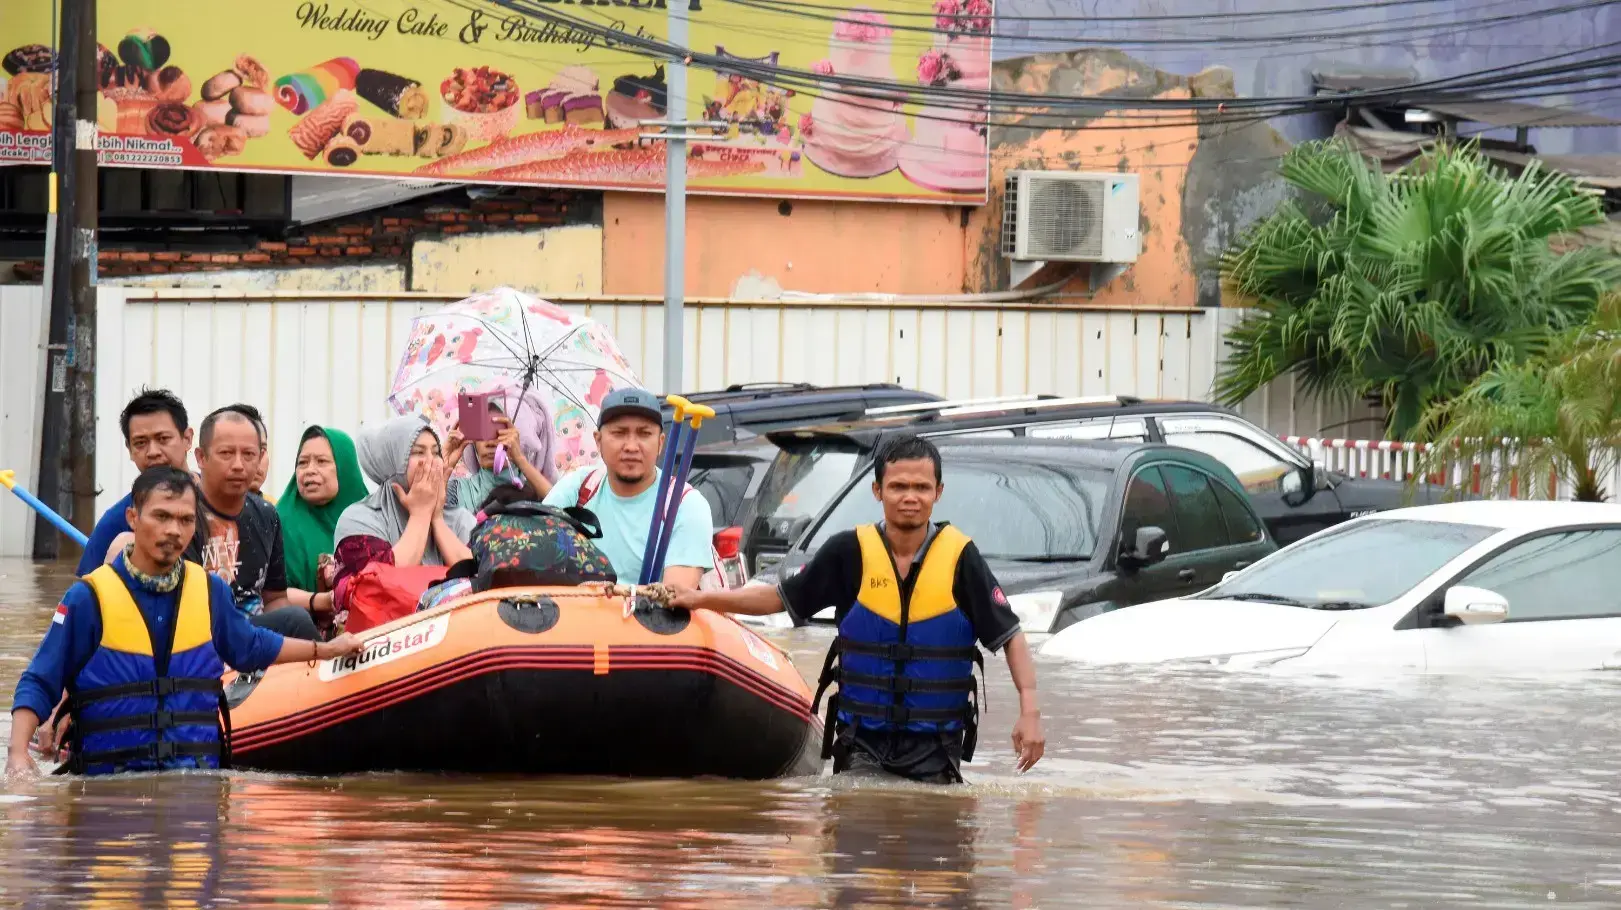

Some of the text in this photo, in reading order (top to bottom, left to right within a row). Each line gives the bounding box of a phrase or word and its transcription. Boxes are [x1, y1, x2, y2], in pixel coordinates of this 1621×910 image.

[296, 1, 390, 41] Wedding
[396, 8, 449, 37] Cake
[458, 9, 489, 44] &
[495, 14, 595, 53] Birthday
[870, 577, 888, 589] BKS
[331, 625, 434, 675] liquidstar
